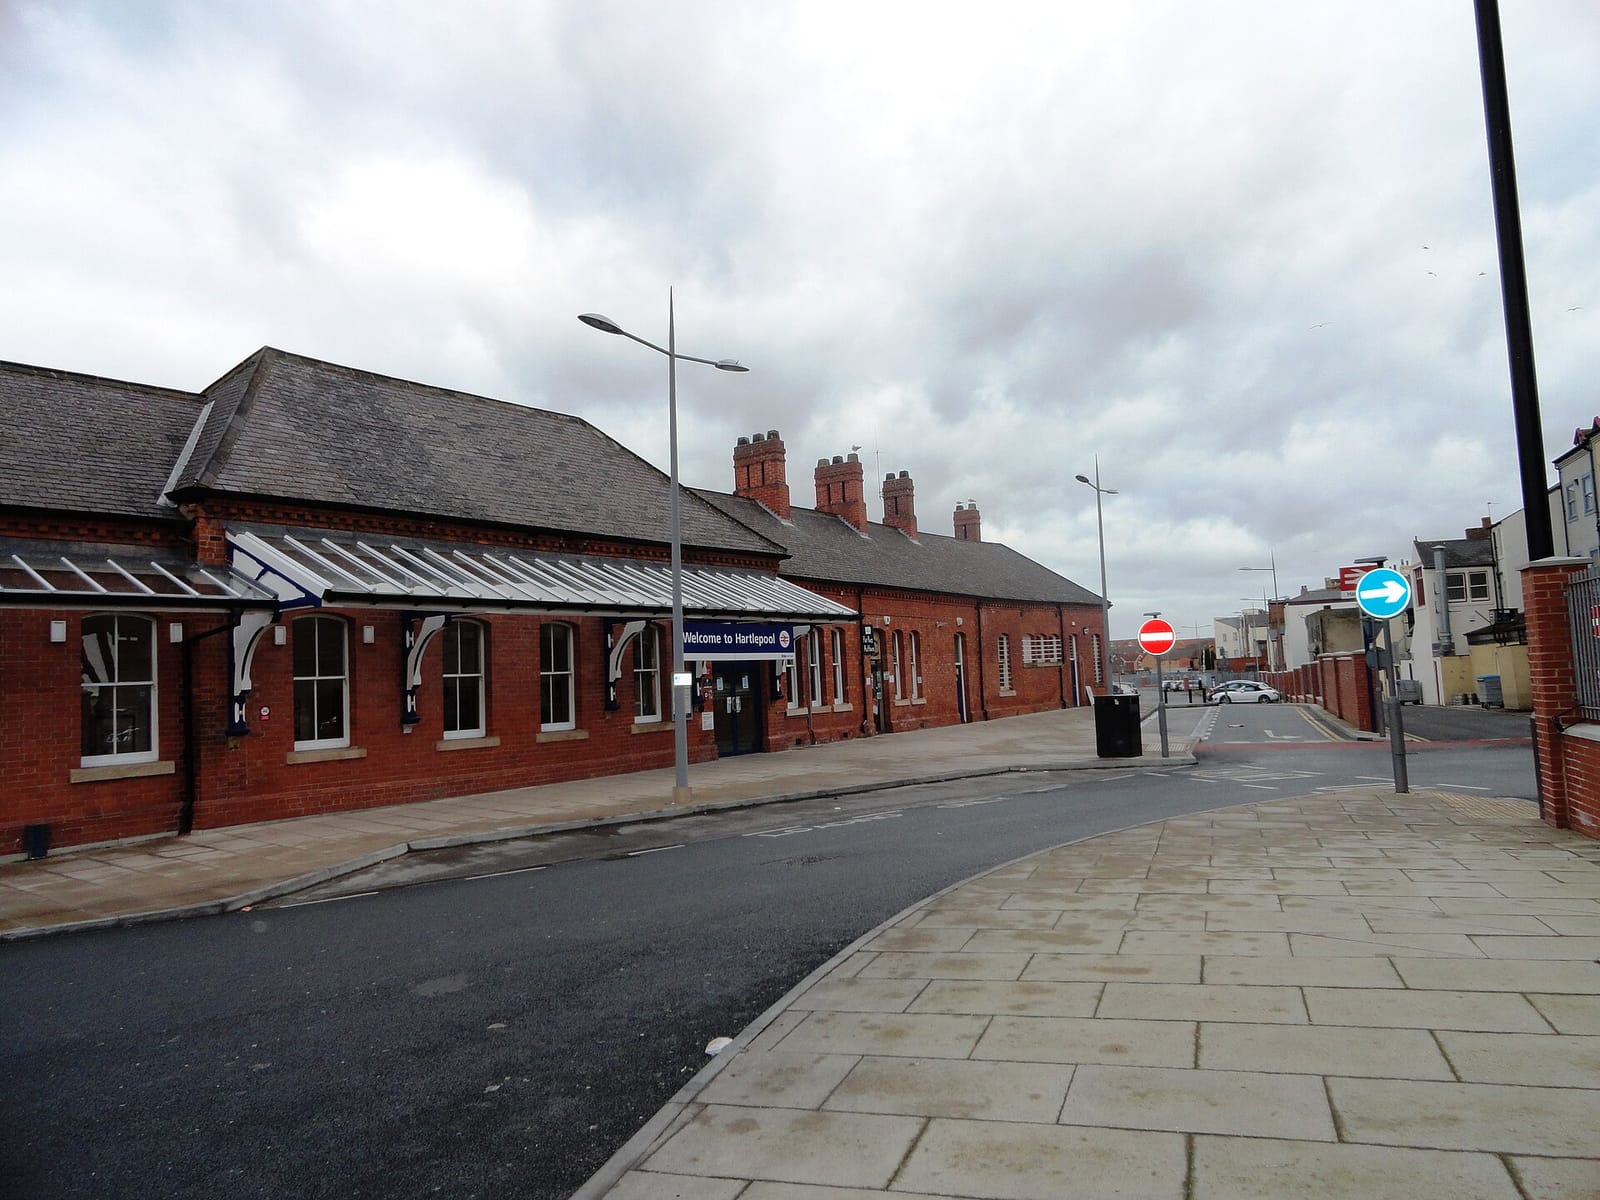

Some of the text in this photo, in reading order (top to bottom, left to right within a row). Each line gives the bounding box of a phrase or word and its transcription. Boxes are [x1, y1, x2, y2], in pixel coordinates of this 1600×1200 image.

[683, 632, 776, 647] Welcome to Hartlepool
